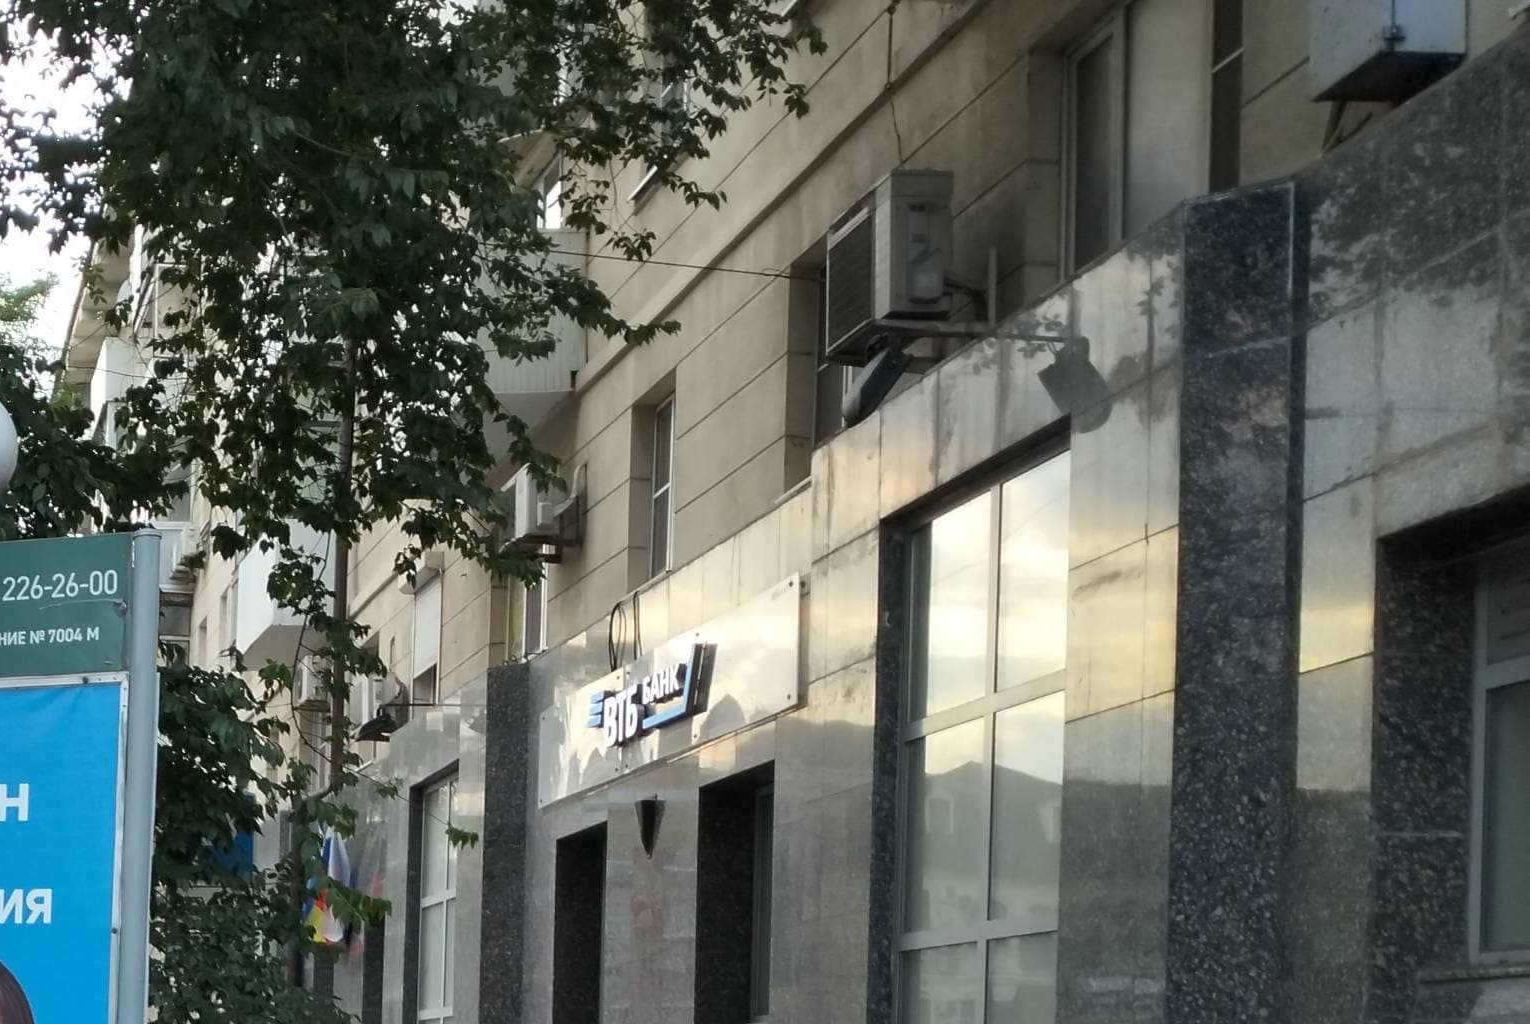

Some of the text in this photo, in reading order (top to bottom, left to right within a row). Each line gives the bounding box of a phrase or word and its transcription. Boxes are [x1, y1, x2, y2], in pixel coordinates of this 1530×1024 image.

[2, 570, 118, 602] 226-26-00
[29, 629, 46, 646] №
[48, 627, 83, 645] 7004
[86, 626, 100, 642] М
[602, 662, 682, 747] ВТБ БАНК
